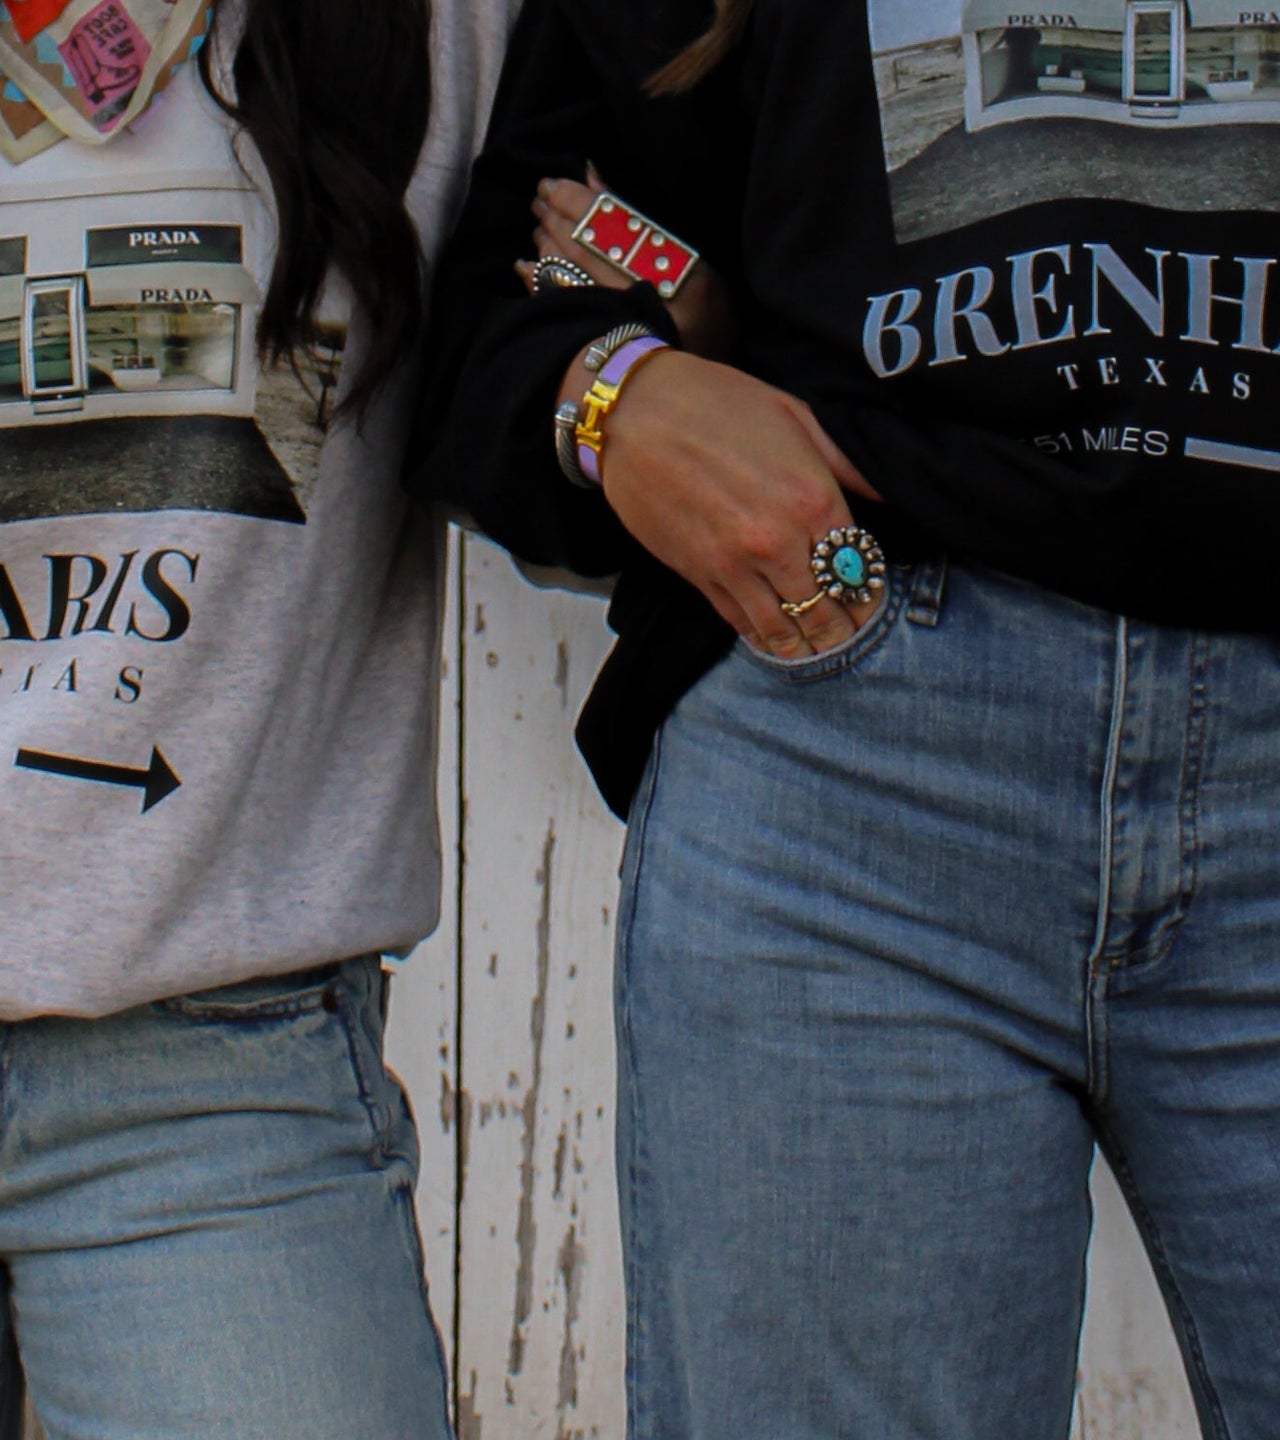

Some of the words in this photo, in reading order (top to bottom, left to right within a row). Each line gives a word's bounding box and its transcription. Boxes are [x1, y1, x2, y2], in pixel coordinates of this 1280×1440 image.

[1006, 14, 1078, 28] PRADA
[128, 230, 201, 247] PRADA
[140, 288, 213, 302] PRADA
[1057, 356, 1252, 400] TEXAS
[1082, 425, 1170, 457] MILES
